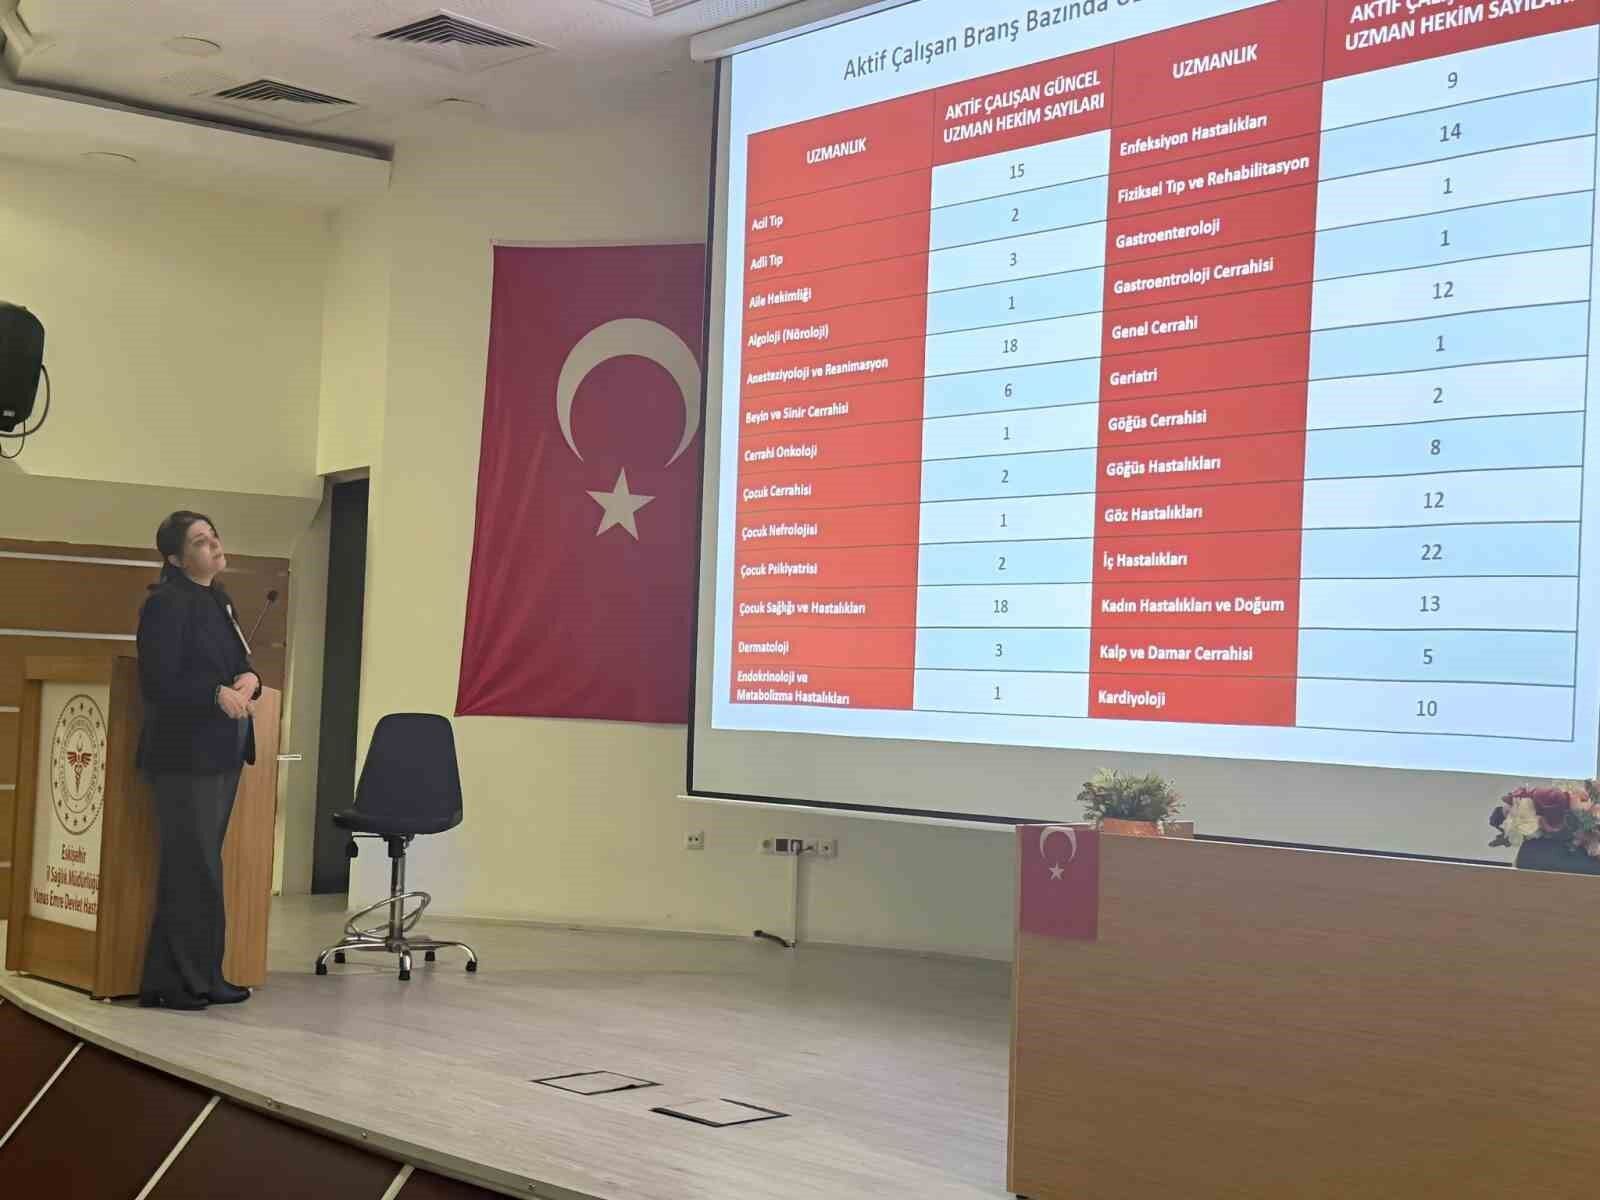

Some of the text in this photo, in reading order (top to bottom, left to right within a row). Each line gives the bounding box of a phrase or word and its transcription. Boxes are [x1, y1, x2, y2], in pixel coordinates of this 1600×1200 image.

[1345, 22, 1416, 51] UZMAN
[1420, 5, 1484, 35] HEKİM
[843, 0, 1109, 81] Aktif Çalışan Branş Bazında
[1172, 43, 1258, 79] UZMANLIK
[1447, 71, 1458, 89] 9
[945, 70, 1101, 121] AKTİF ÇALIŞAN GÜNCEL
[943, 92, 1105, 143] UZMAN HEKİM SAYILARI
[1119, 114, 1268, 157] Enfeksiyon Hastalıkları
[1439, 122, 1462, 143] 14
[806, 137, 867, 164] UZMANLIK
[1009, 162, 1025, 180] 15
[1117, 156, 1310, 203] Fiziksel Tıp ve Rehabilitasyon
[1443, 177, 1453, 195] 1
[751, 214, 784, 231] Acil Tıp
[1011, 207, 1019, 223] 2
[1115, 217, 1221, 249] Gastroenteroloji
[1440, 229, 1451, 247] 1
[750, 254, 784, 271] Adli Tıp
[1009, 252, 1017, 267] 3
[1113, 256, 1274, 294] Gastroentroloji Cerrahisi
[1432, 280, 1454, 300] 12
[749, 294, 766, 308] Aile
[1008, 295, 1016, 311] 1
[1111, 315, 1198, 340] Genel Cerrahi
[747, 330, 781, 348] Algoloji
[1002, 338, 1018, 354] 18
[1435, 335, 1446, 353] 1
[811, 367, 824, 378] ve
[824, 358, 889, 376] Reanimasyon
[1109, 367, 1158, 386] Geriatri
[1004, 383, 1013, 398] 6
[1432, 387, 1444, 404] 2
[745, 401, 849, 425] Beyin ve Sinir Cerrahisi
[1107, 409, 1207, 433] Göğüs Cerrahisi
[1003, 426, 1011, 441] 1
[744, 444, 818, 462] Cerrahi Onkoloji
[1430, 439, 1441, 456] 8
[1106, 455, 1221, 479] Göğüs Hastalıkları
[1001, 469, 1009, 484] 2
[742, 483, 812, 502] Çocuk Cerrahisi
[1423, 491, 1445, 509] 12
[999, 513, 1008, 528] 1
[1104, 503, 1203, 523] Göz Hastalıkları
[741, 523, 818, 541] Çocuk Nefrolojisi
[1103, 551, 1188, 570] İç Hastalıkları
[1421, 543, 1443, 561] 22
[740, 561, 818, 579] Çocuk Psikiyatrisi
[997, 556, 1007, 571] 2
[739, 601, 766, 617] Çocuk
[796, 603, 810, 614] ve
[810, 601, 866, 615] Hastalıkları
[993, 599, 1009, 614] 18
[1101, 596, 1285, 615] Kadın Hastalıkları ve Doğum
[1419, 595, 1441, 613] 13
[737, 640, 790, 656] Dermatoloji
[995, 643, 1003, 658] 3
[1099, 644, 1253, 662] Kalp ve Damar Cerrahisi
[1423, 648, 1433, 665] 5
[736, 669, 808, 686] Endokrinoloji ve
[736, 688, 850, 706] Metabolizma Hastalıkları
[993, 685, 1001, 701] 1
[1098, 689, 1166, 709] Kardiyoloji
[1416, 700, 1438, 717] 10
